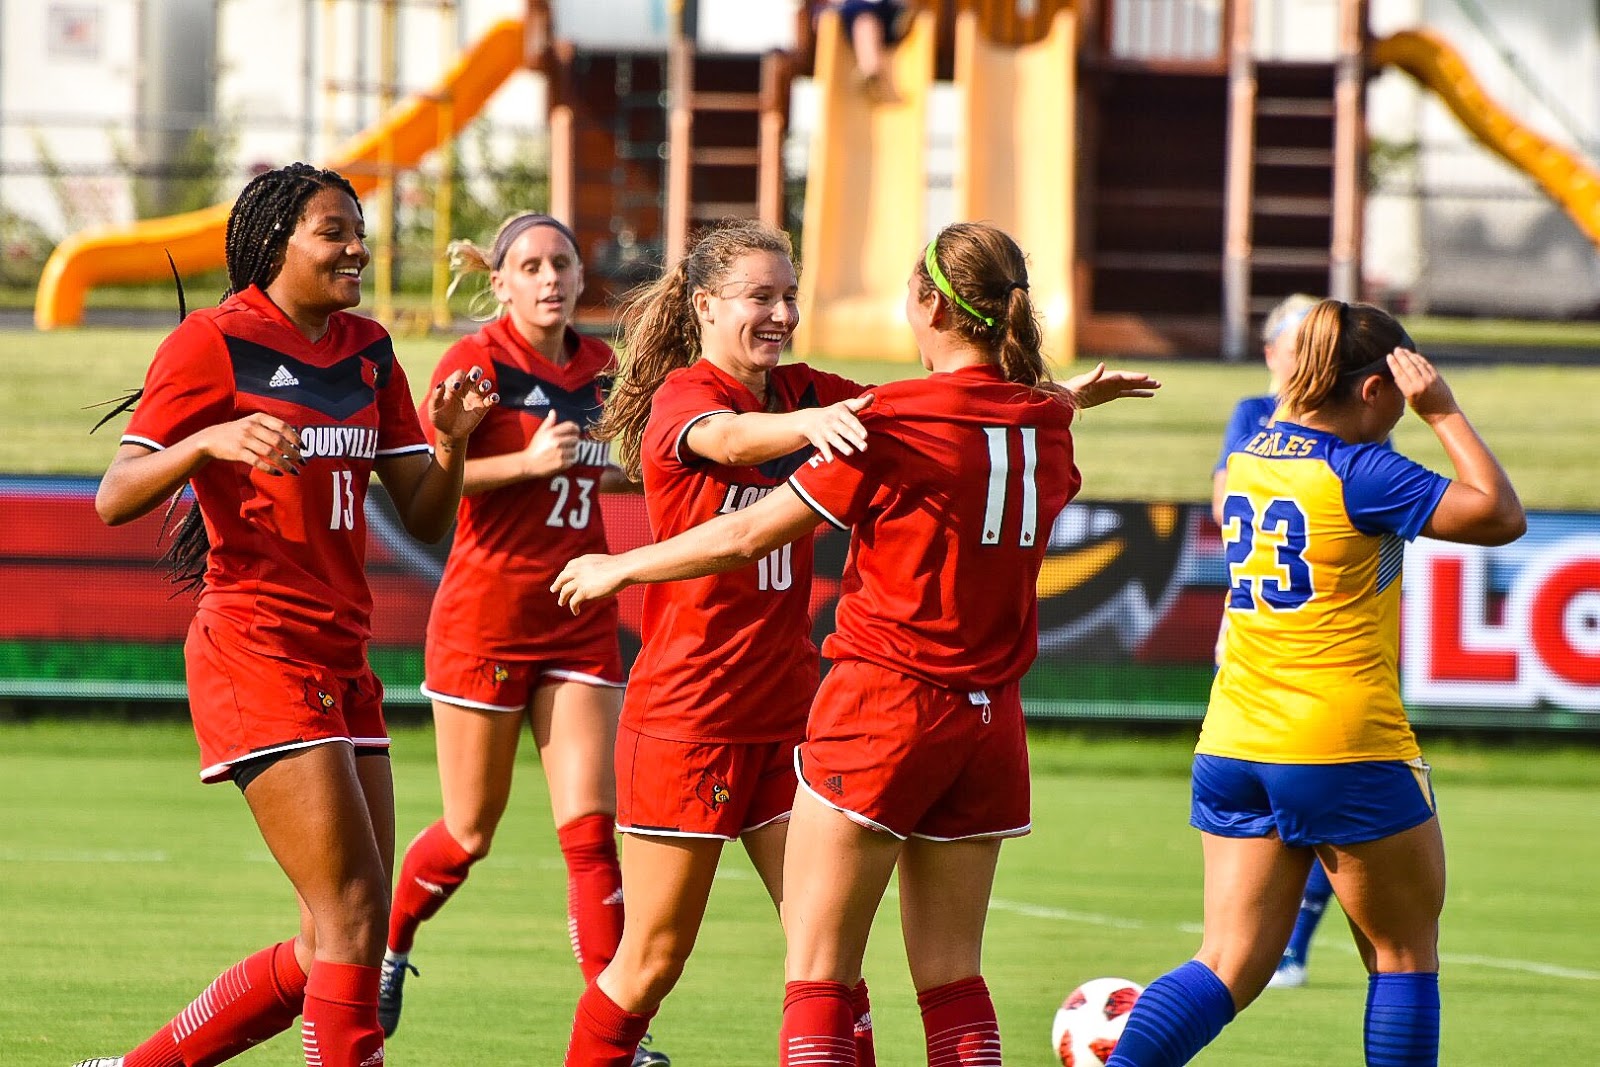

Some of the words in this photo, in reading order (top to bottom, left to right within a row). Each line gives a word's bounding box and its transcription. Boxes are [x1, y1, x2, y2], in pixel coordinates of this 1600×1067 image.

[269, 376, 299, 388] adidas
[300, 427, 378, 459] OUISVILL
[330, 470, 354, 531] 13
[545, 475, 595, 530] 23
[981, 427, 1038, 547] 11
[758, 541, 792, 591] 10
[1222, 493, 1316, 612] 23
